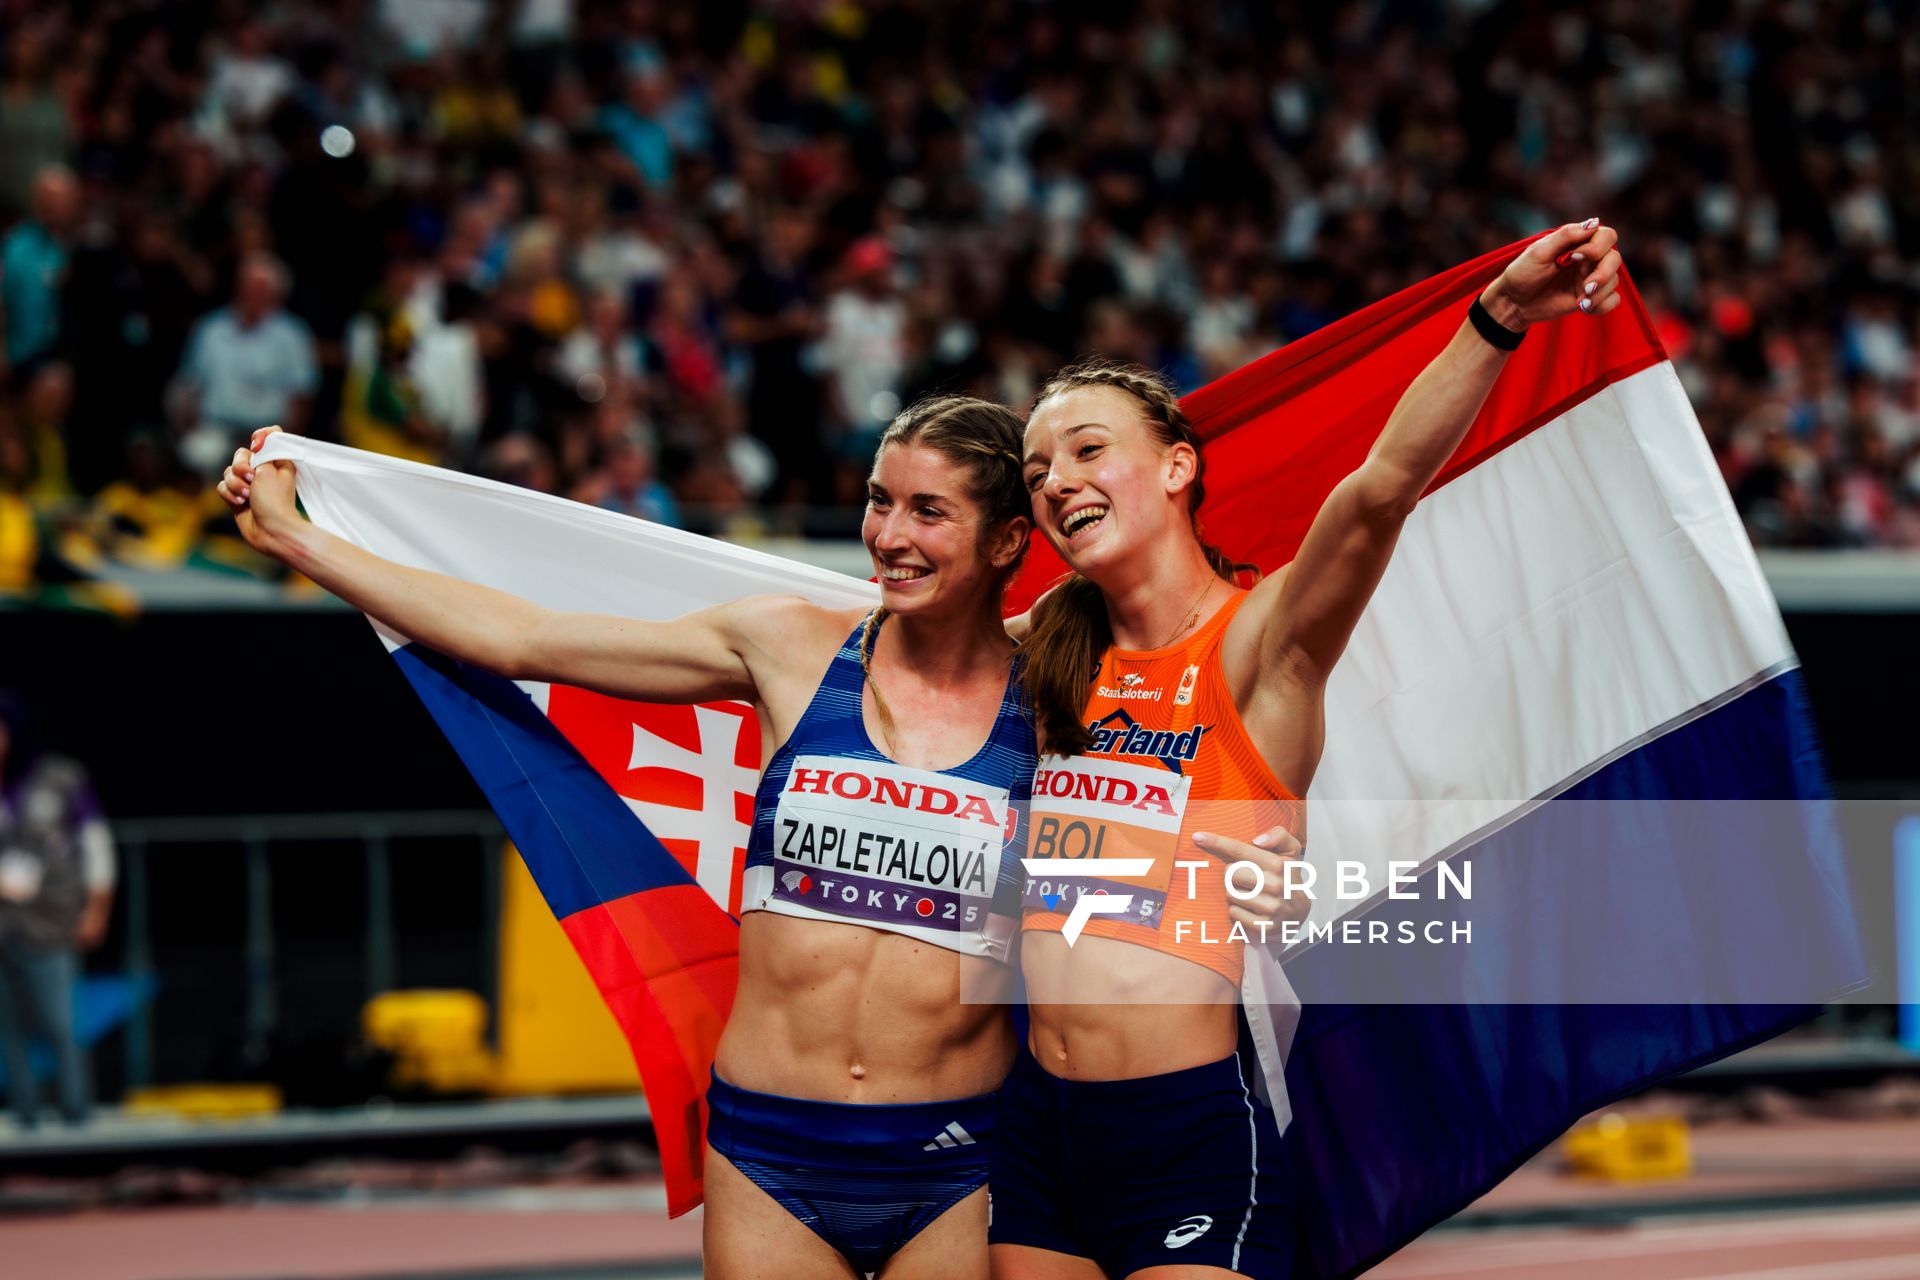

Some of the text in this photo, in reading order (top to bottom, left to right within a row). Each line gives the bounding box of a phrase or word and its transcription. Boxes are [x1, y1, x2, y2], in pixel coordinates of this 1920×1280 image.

[1097, 686, 1163, 701] Staatsloterij
[788, 768, 1000, 827] HONDA
[1032, 770, 1178, 816] HONDA
[781, 818, 988, 893] ZAPLETALOVÁ
